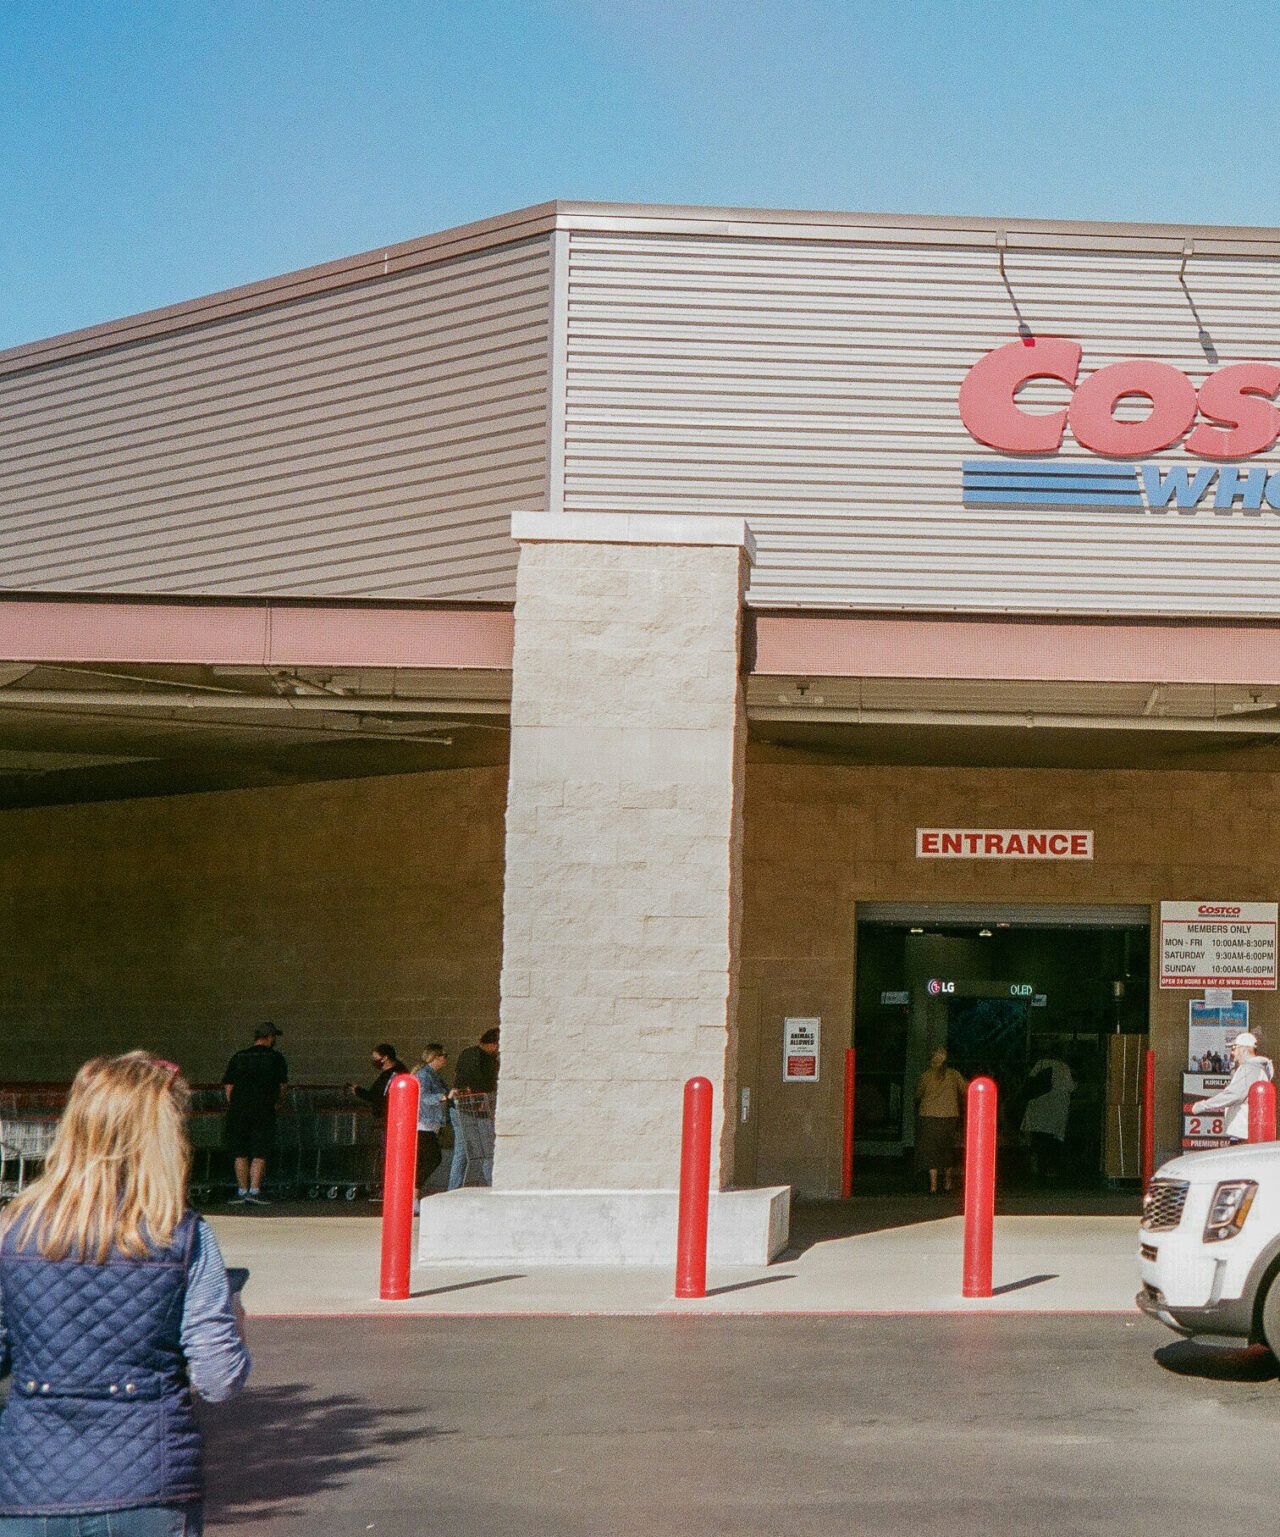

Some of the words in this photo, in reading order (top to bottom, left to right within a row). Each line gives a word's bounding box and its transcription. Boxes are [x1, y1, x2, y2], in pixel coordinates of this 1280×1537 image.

[921, 833, 1088, 855] ENTRANCE
[1198, 905, 1241, 914] COSTCO
[1187, 925, 1228, 933] MEMBERS
[1230, 925, 1252, 934] ONLY
[1165, 938, 1183, 946] MON
[1190, 939, 1203, 947] FRI
[1164, 951, 1206, 959] SATURDAY
[1164, 964, 1196, 972] SUNDAY
[941, 982, 955, 992] LG
[1010, 985, 1033, 996] OLED
